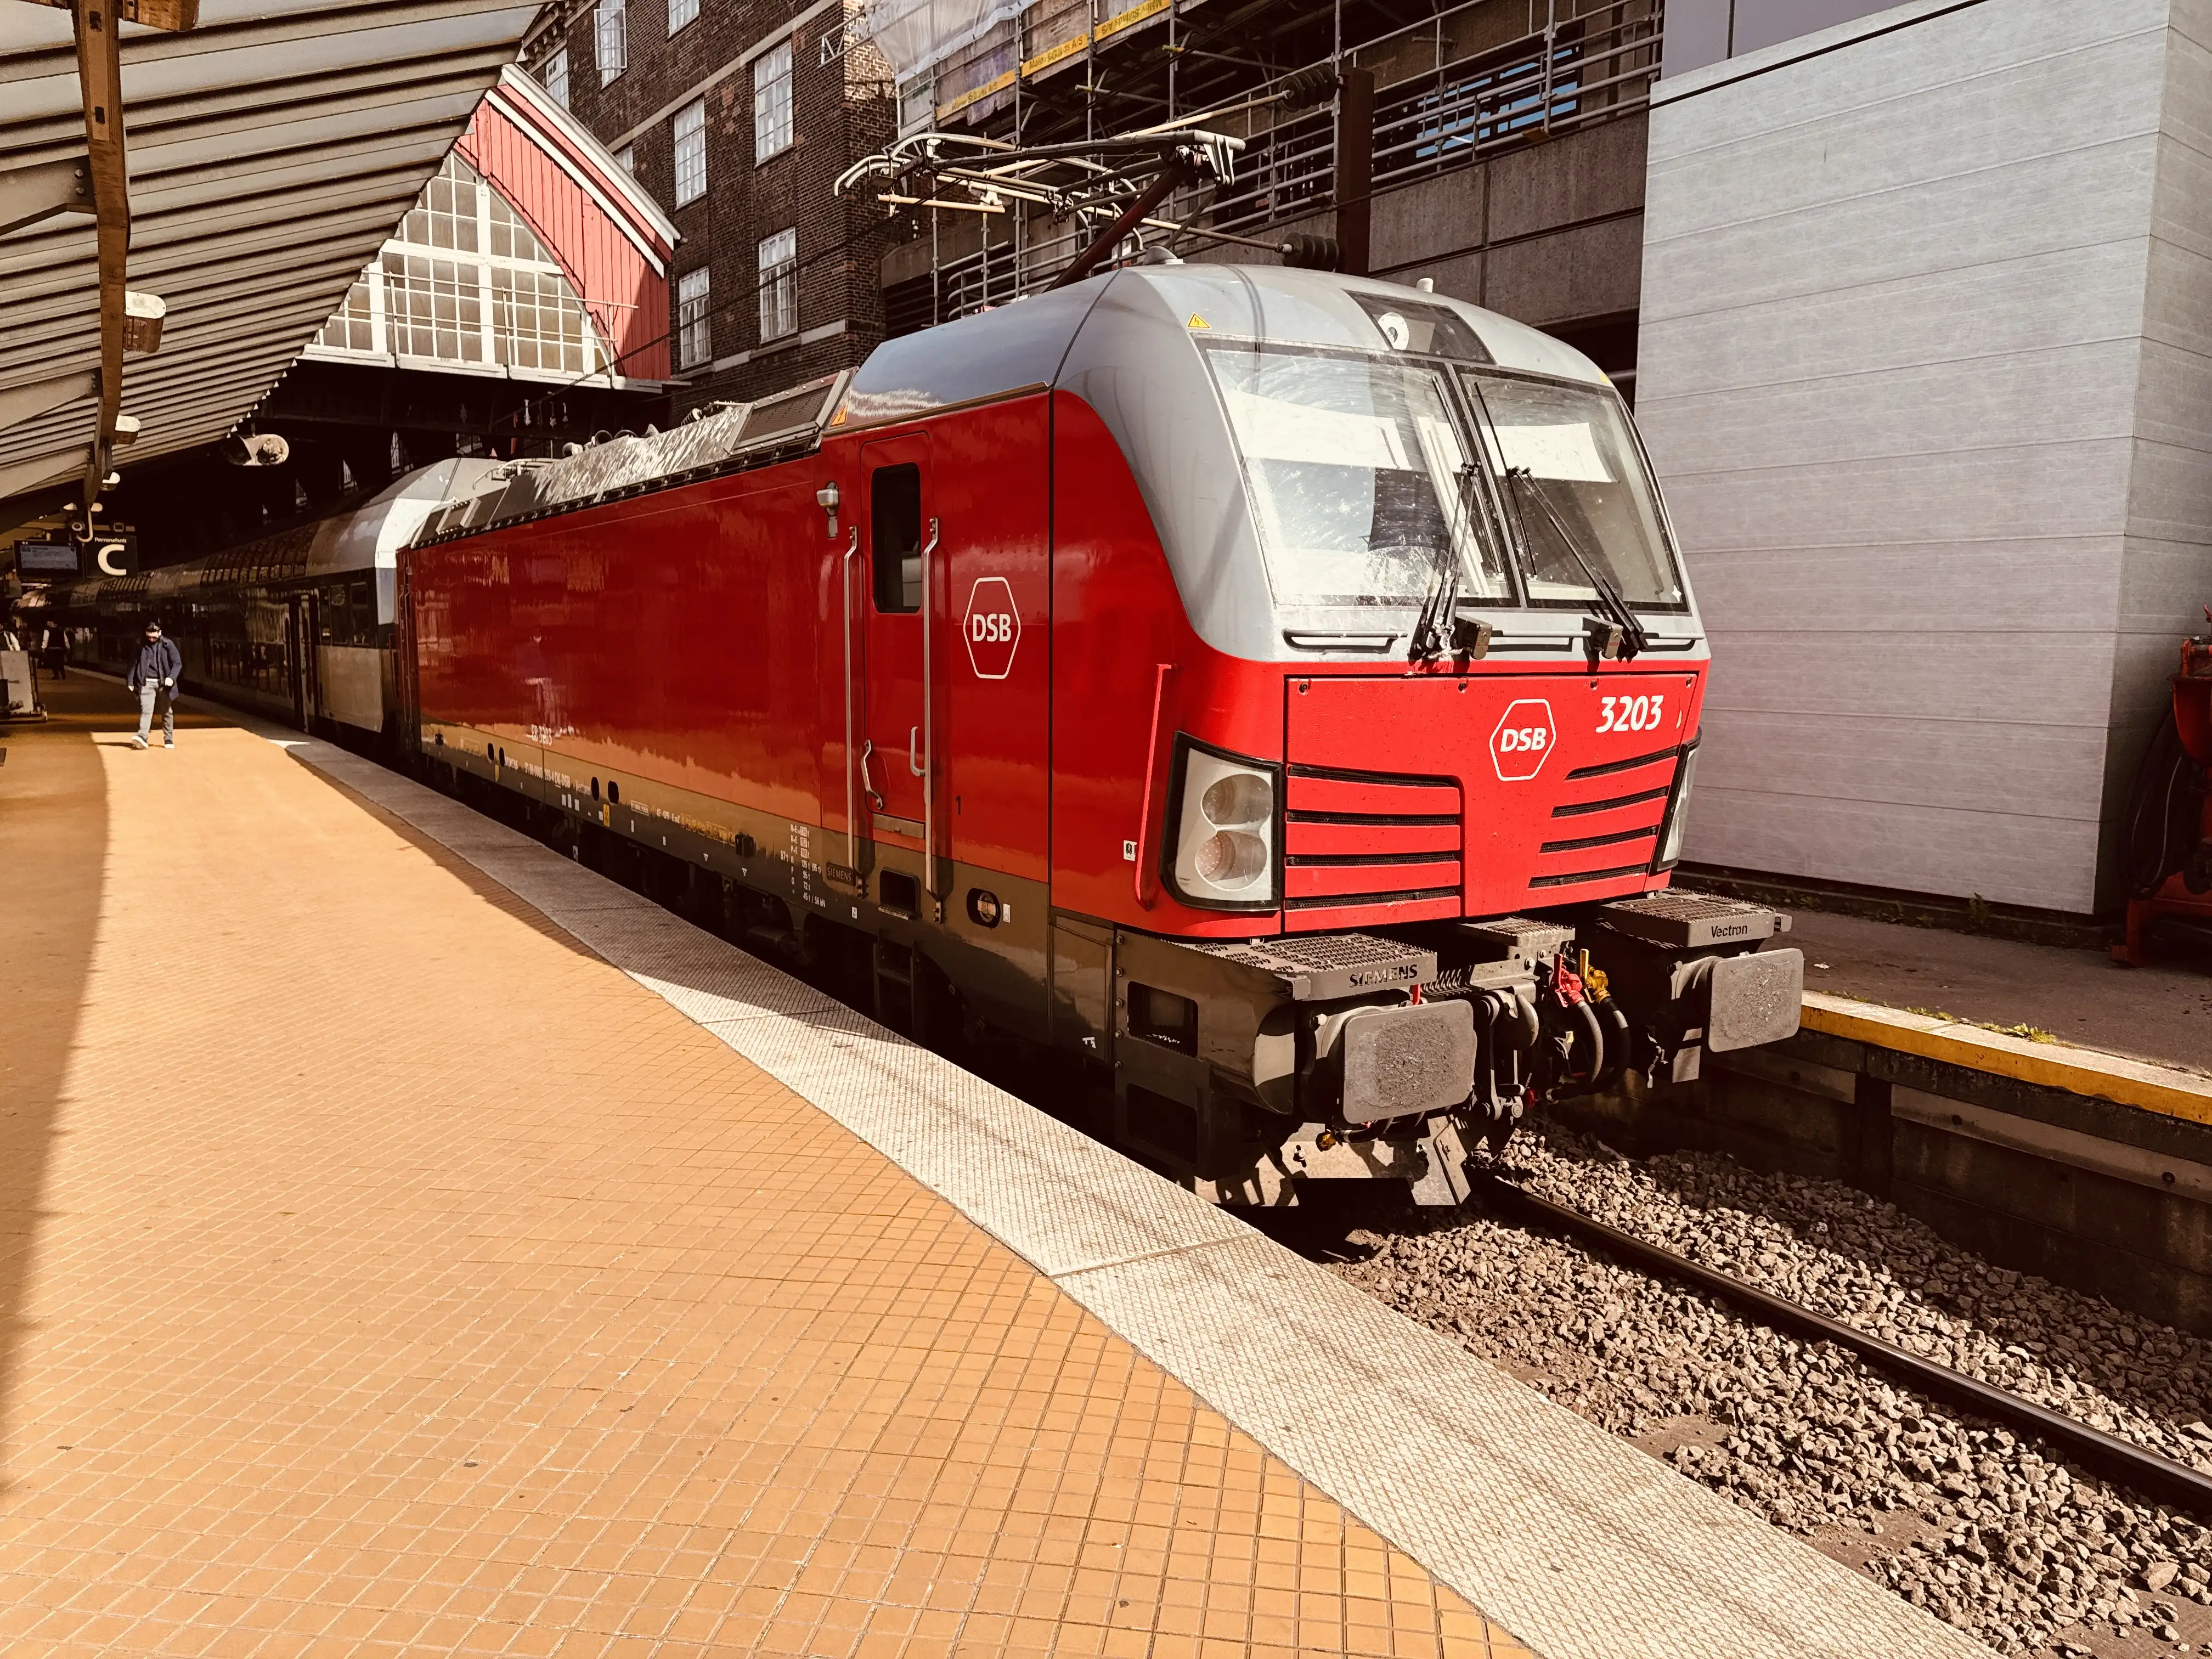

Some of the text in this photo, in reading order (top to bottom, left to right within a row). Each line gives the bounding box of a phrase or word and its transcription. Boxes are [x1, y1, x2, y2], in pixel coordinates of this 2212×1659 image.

[98, 544, 127, 575] C
[973, 613, 1012, 642] DSB
[1595, 695, 1664, 733] 3203
[1500, 727, 1547, 752] DSB
[956, 795, 961, 815] 1
[827, 867, 851, 882] SIEMENS
[1711, 925, 1748, 938] Vectron
[1349, 964, 1418, 988] SIEMENS
